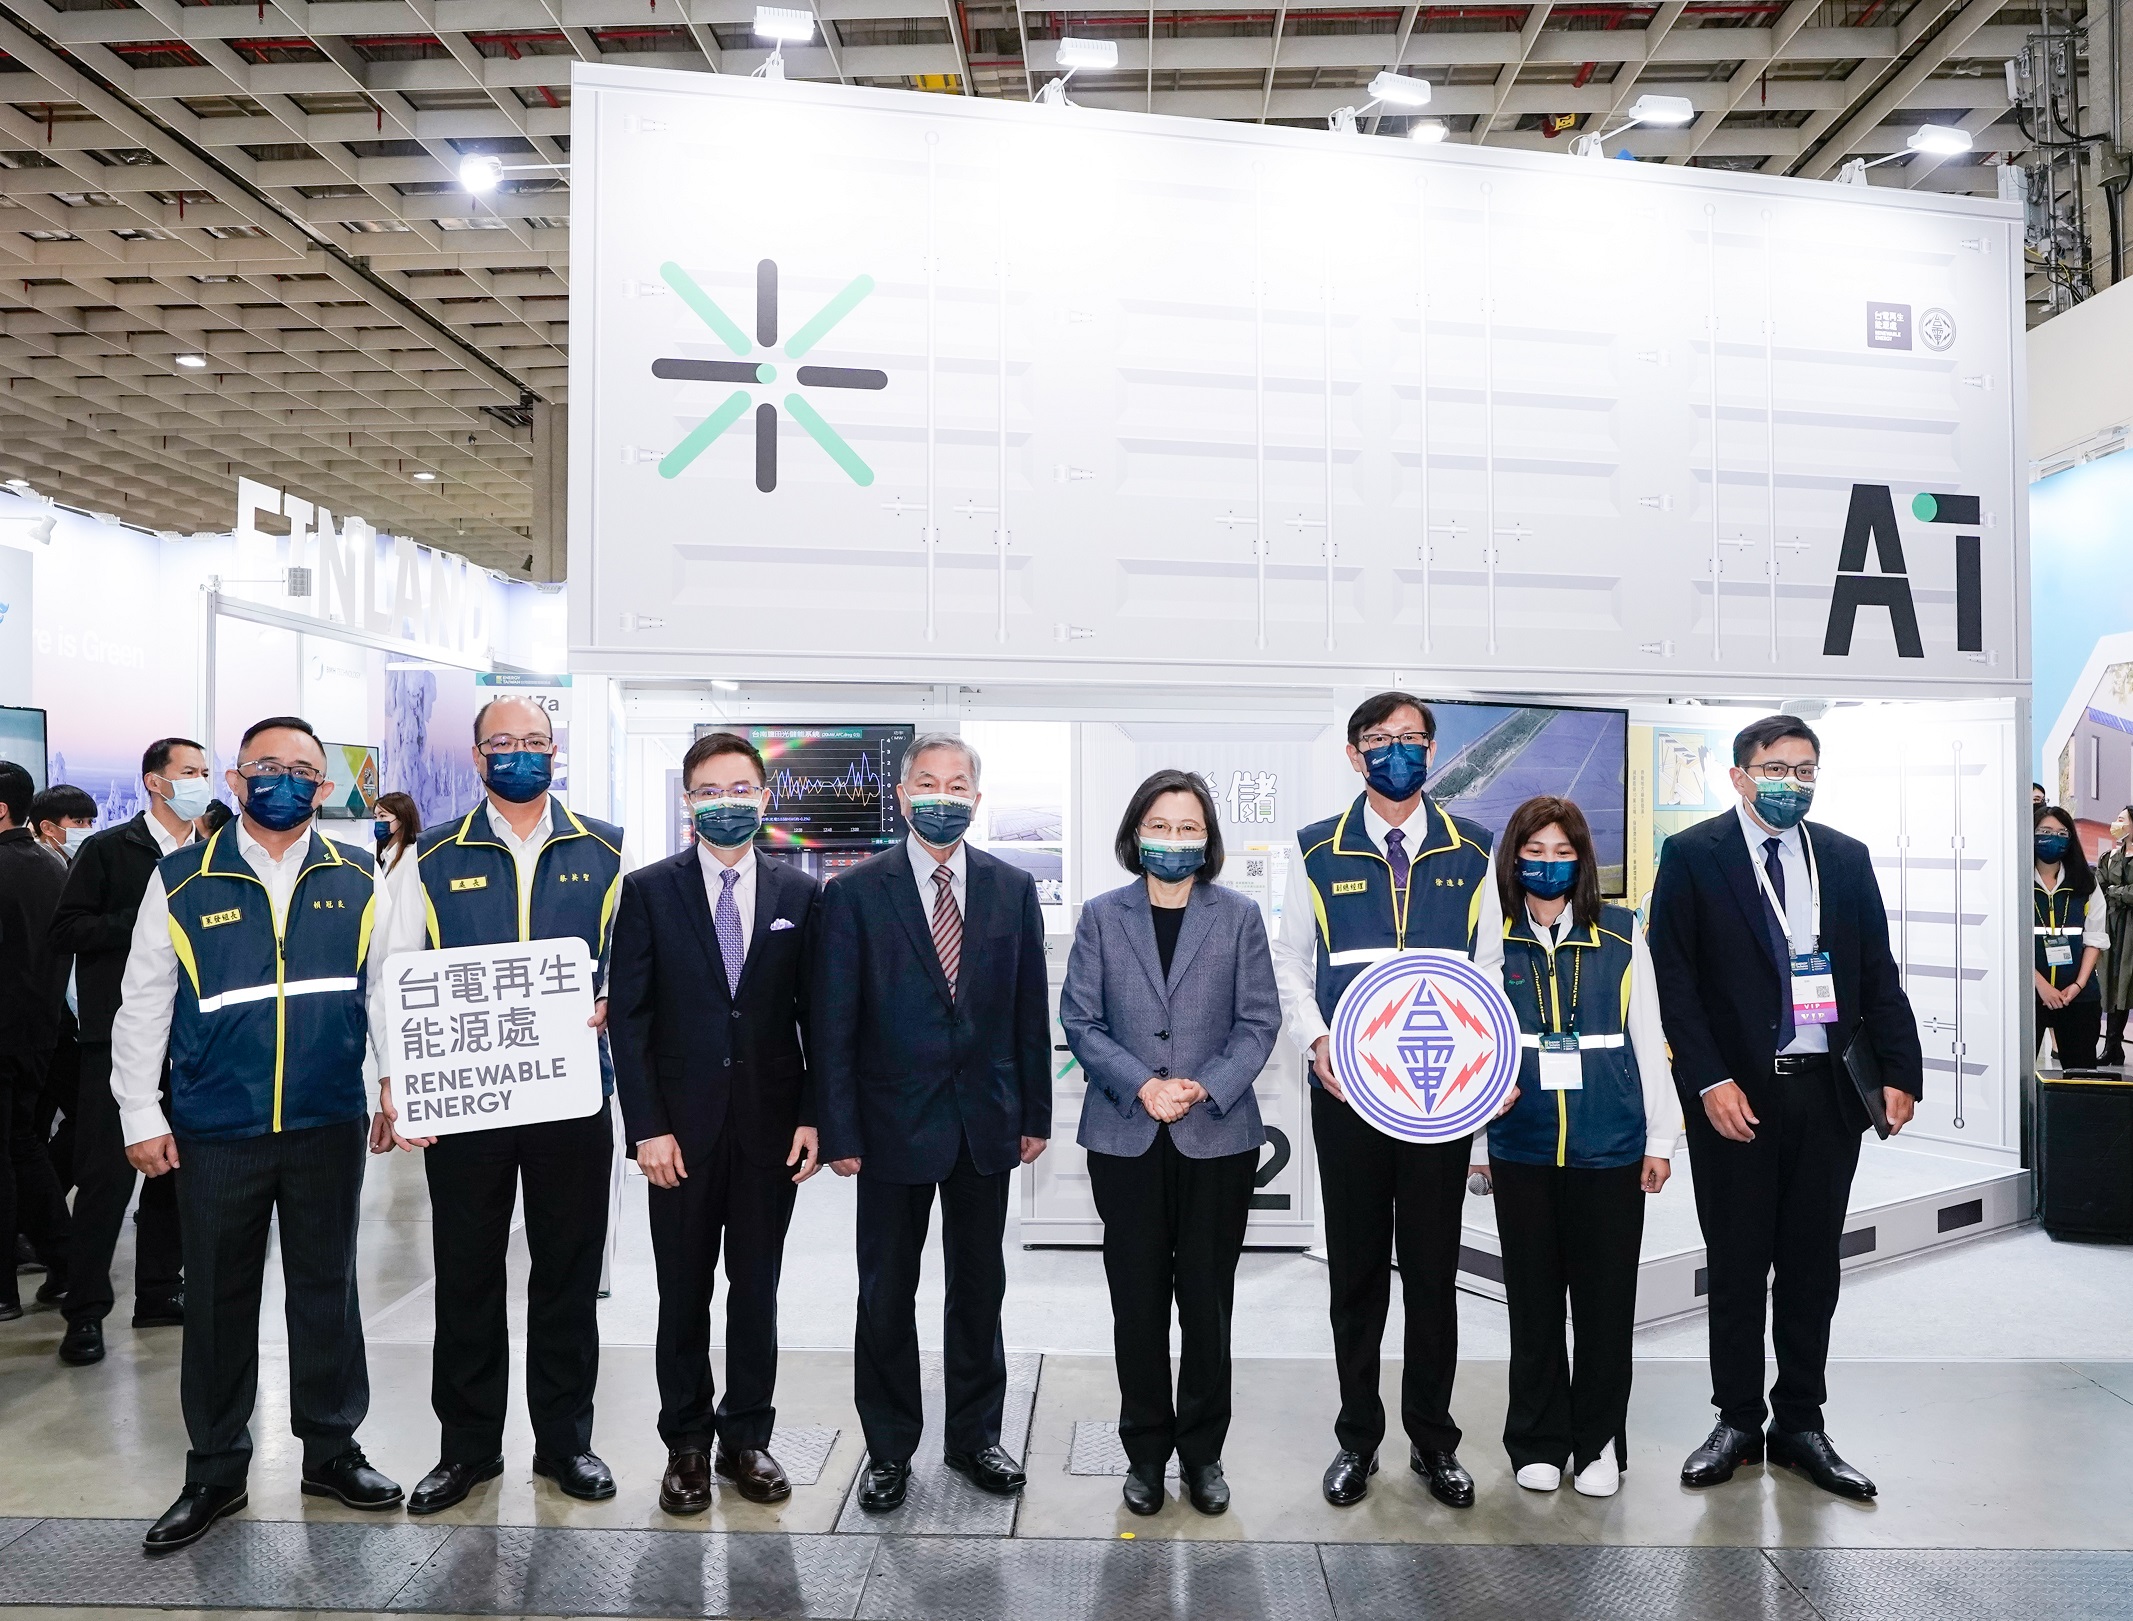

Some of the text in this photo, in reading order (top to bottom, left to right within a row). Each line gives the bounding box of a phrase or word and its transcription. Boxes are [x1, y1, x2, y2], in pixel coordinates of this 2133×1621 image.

[238, 476, 491, 658] FINLAND
[57, 624, 77, 659] is
[82, 630, 145, 669] Green
[398, 954, 581, 1011] 台電再生
[401, 1006, 540, 1061] 能源處
[1800, 1012, 1825, 1021] VIP
[405, 1057, 567, 1096] RENEWABLE
[407, 1089, 512, 1123] ENERGY
[1249, 1125, 1291, 1210] 2
